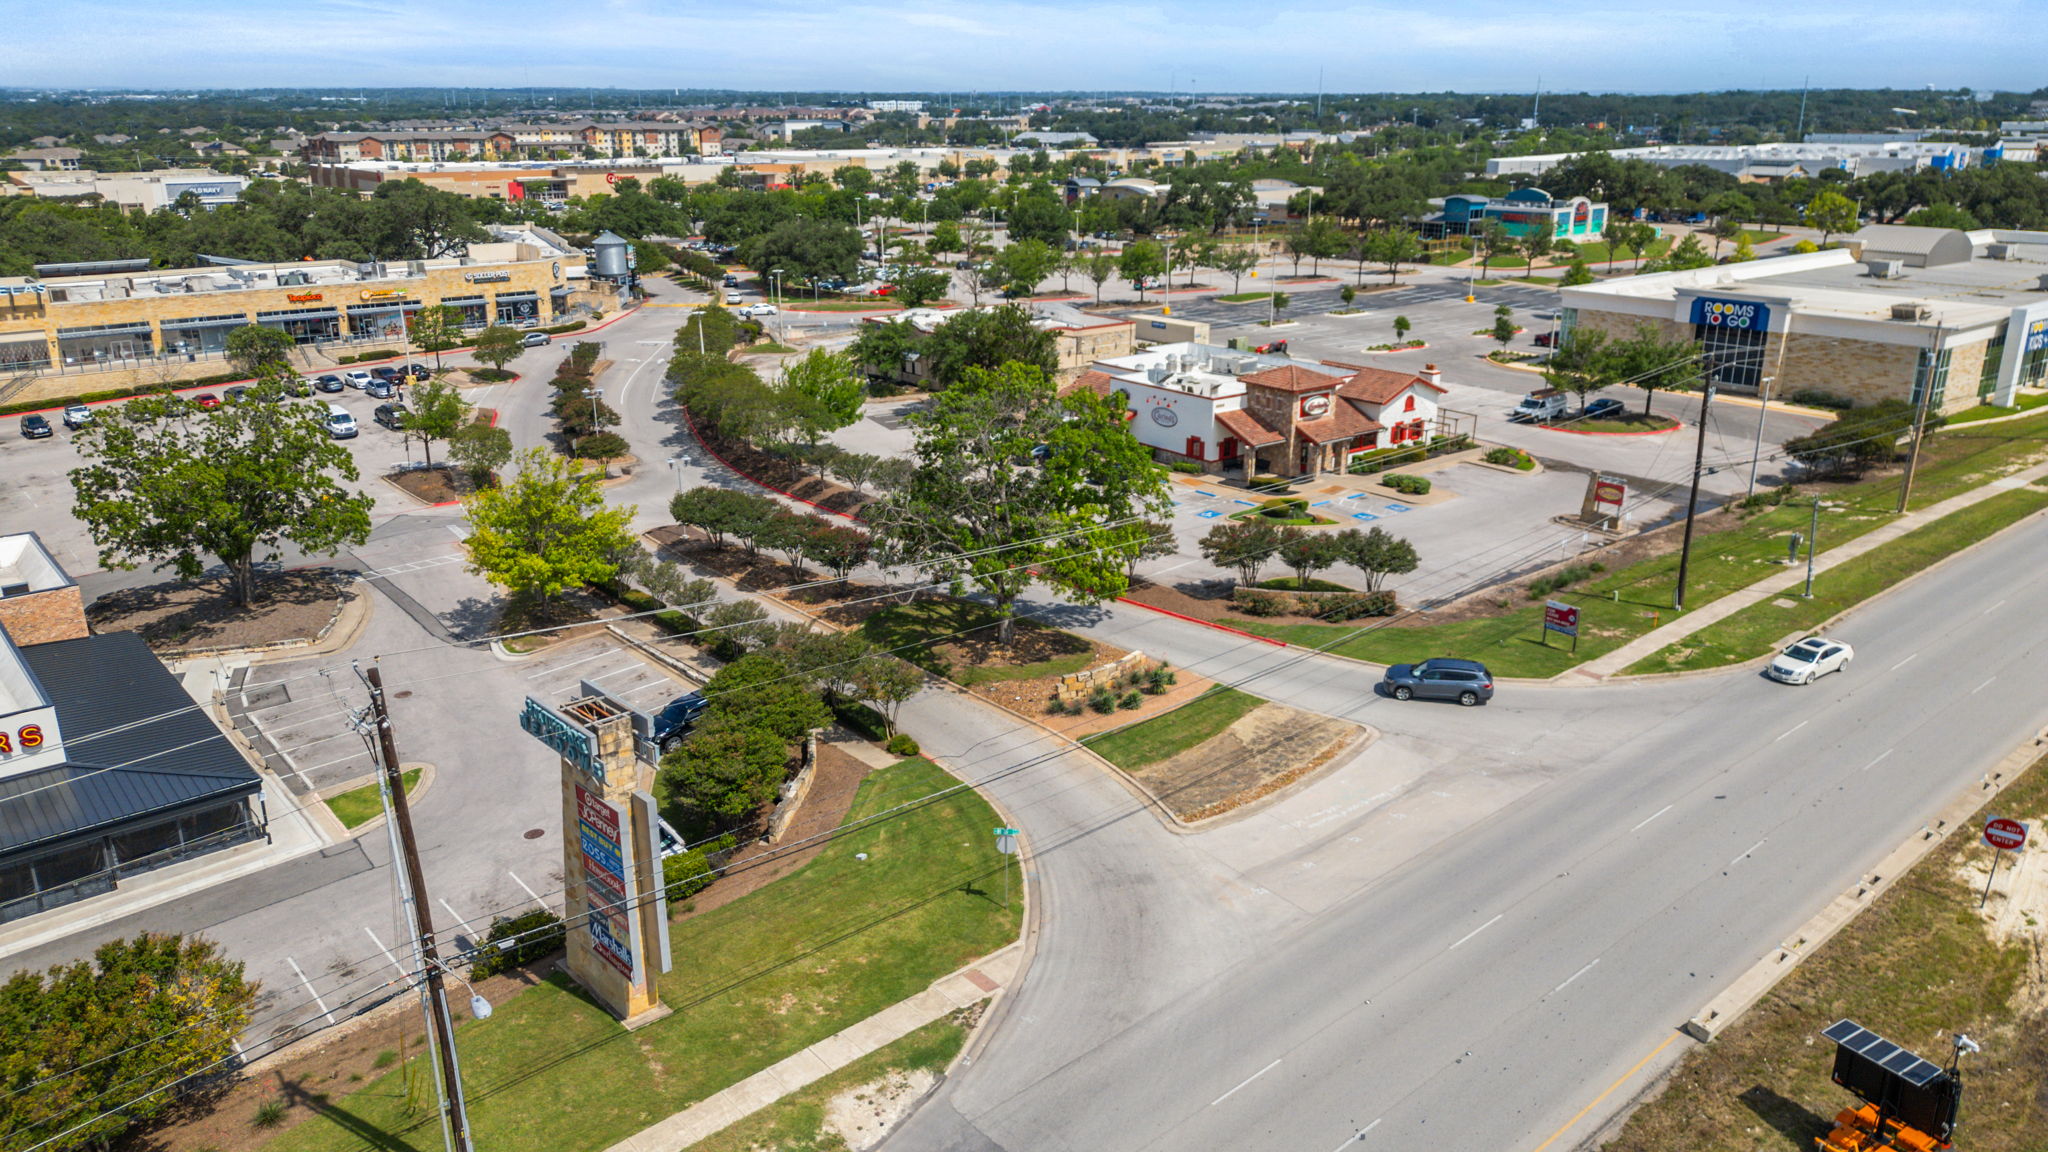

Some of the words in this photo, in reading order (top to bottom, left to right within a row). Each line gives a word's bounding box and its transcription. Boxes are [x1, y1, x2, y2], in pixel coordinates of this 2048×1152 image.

[497, 270, 511, 278] POST
[1704, 301, 1755, 318] ROOMS
[1705, 313, 1722, 325] TO
[1727, 315, 1750, 328] GO
[583, 805, 620, 842] JCPenney
[1993, 822, 2004, 830] DO
[2006, 825, 2021, 833] NOT
[581, 823, 597, 840] BEST
[598, 836, 613, 851] BUY
[1992, 835, 2014, 845] ENTER
[582, 838, 607, 866] ROSS
[591, 922, 632, 966] Marshalls
